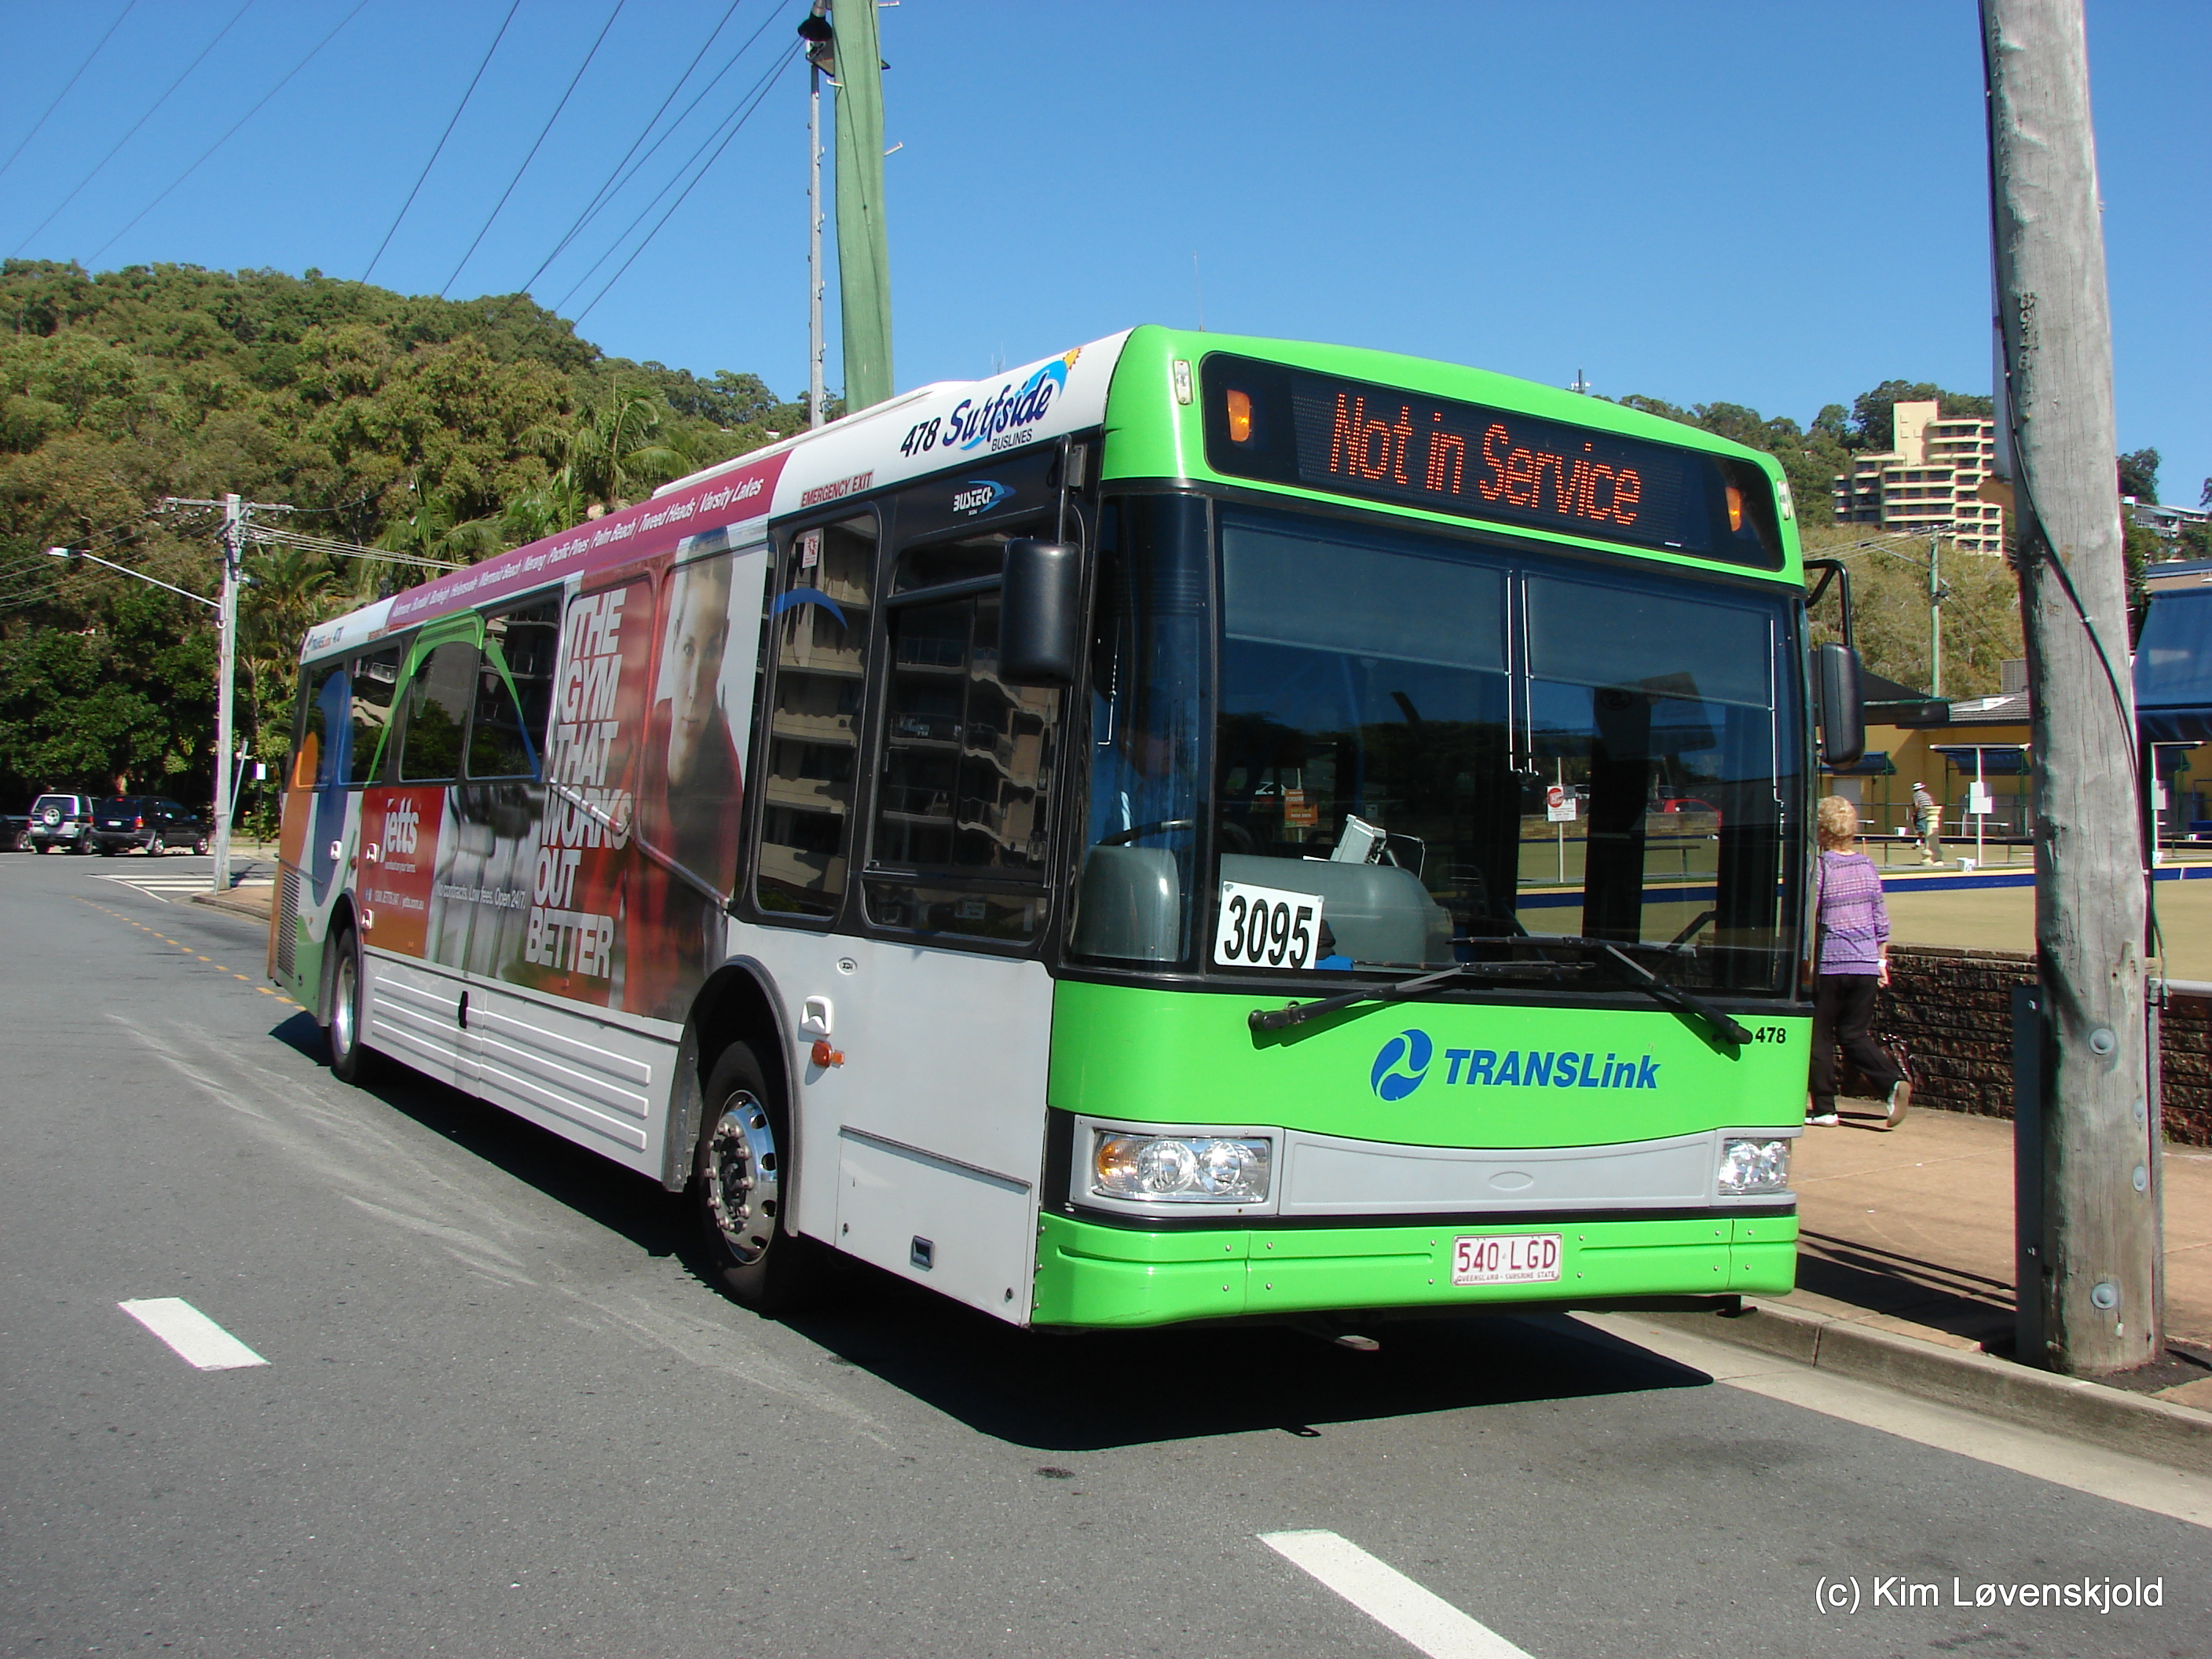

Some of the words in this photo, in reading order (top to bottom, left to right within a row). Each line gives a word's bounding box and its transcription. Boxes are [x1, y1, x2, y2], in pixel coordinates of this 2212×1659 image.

[900, 417, 941, 458] 478
[943, 372, 1053, 446] Surfside
[992, 429, 1033, 452] BUSLINES
[801, 478, 851, 507] EMERGENCY
[852, 472, 873, 493] EXIT
[1331, 394, 1412, 484] Not
[1426, 412, 1465, 494] in
[1479, 424, 1641, 525] Service
[501, 560, 522, 580] Beach
[548, 543, 570, 564] Pacific
[568, 537, 588, 556] Pines
[591, 527, 613, 548] Palm
[610, 518, 636, 542] Beach
[639, 507, 669, 533] Tweed
[667, 498, 696, 522] Heads
[700, 486, 733, 511] Varsity
[732, 478, 764, 503] Lakes
[953, 486, 993, 512] BUSTECH
[568, 588, 627, 660] THE
[562, 654, 622, 723] GYM
[554, 721, 619, 786] THAT
[379, 797, 419, 862] jetts
[542, 786, 632, 851] WORKS
[494, 887, 511, 910] Open
[534, 846, 582, 909] OUT
[525, 906, 614, 980] BETTER
[1224, 895, 1313, 969] 3095
[1755, 1027, 1786, 1044] 478
[1445, 1048, 1662, 1090] TRANSLink
[1458, 1242, 1499, 1273] 540
[1511, 1240, 1557, 1270] LGD
[1537, 1270, 1555, 1279] STATE
